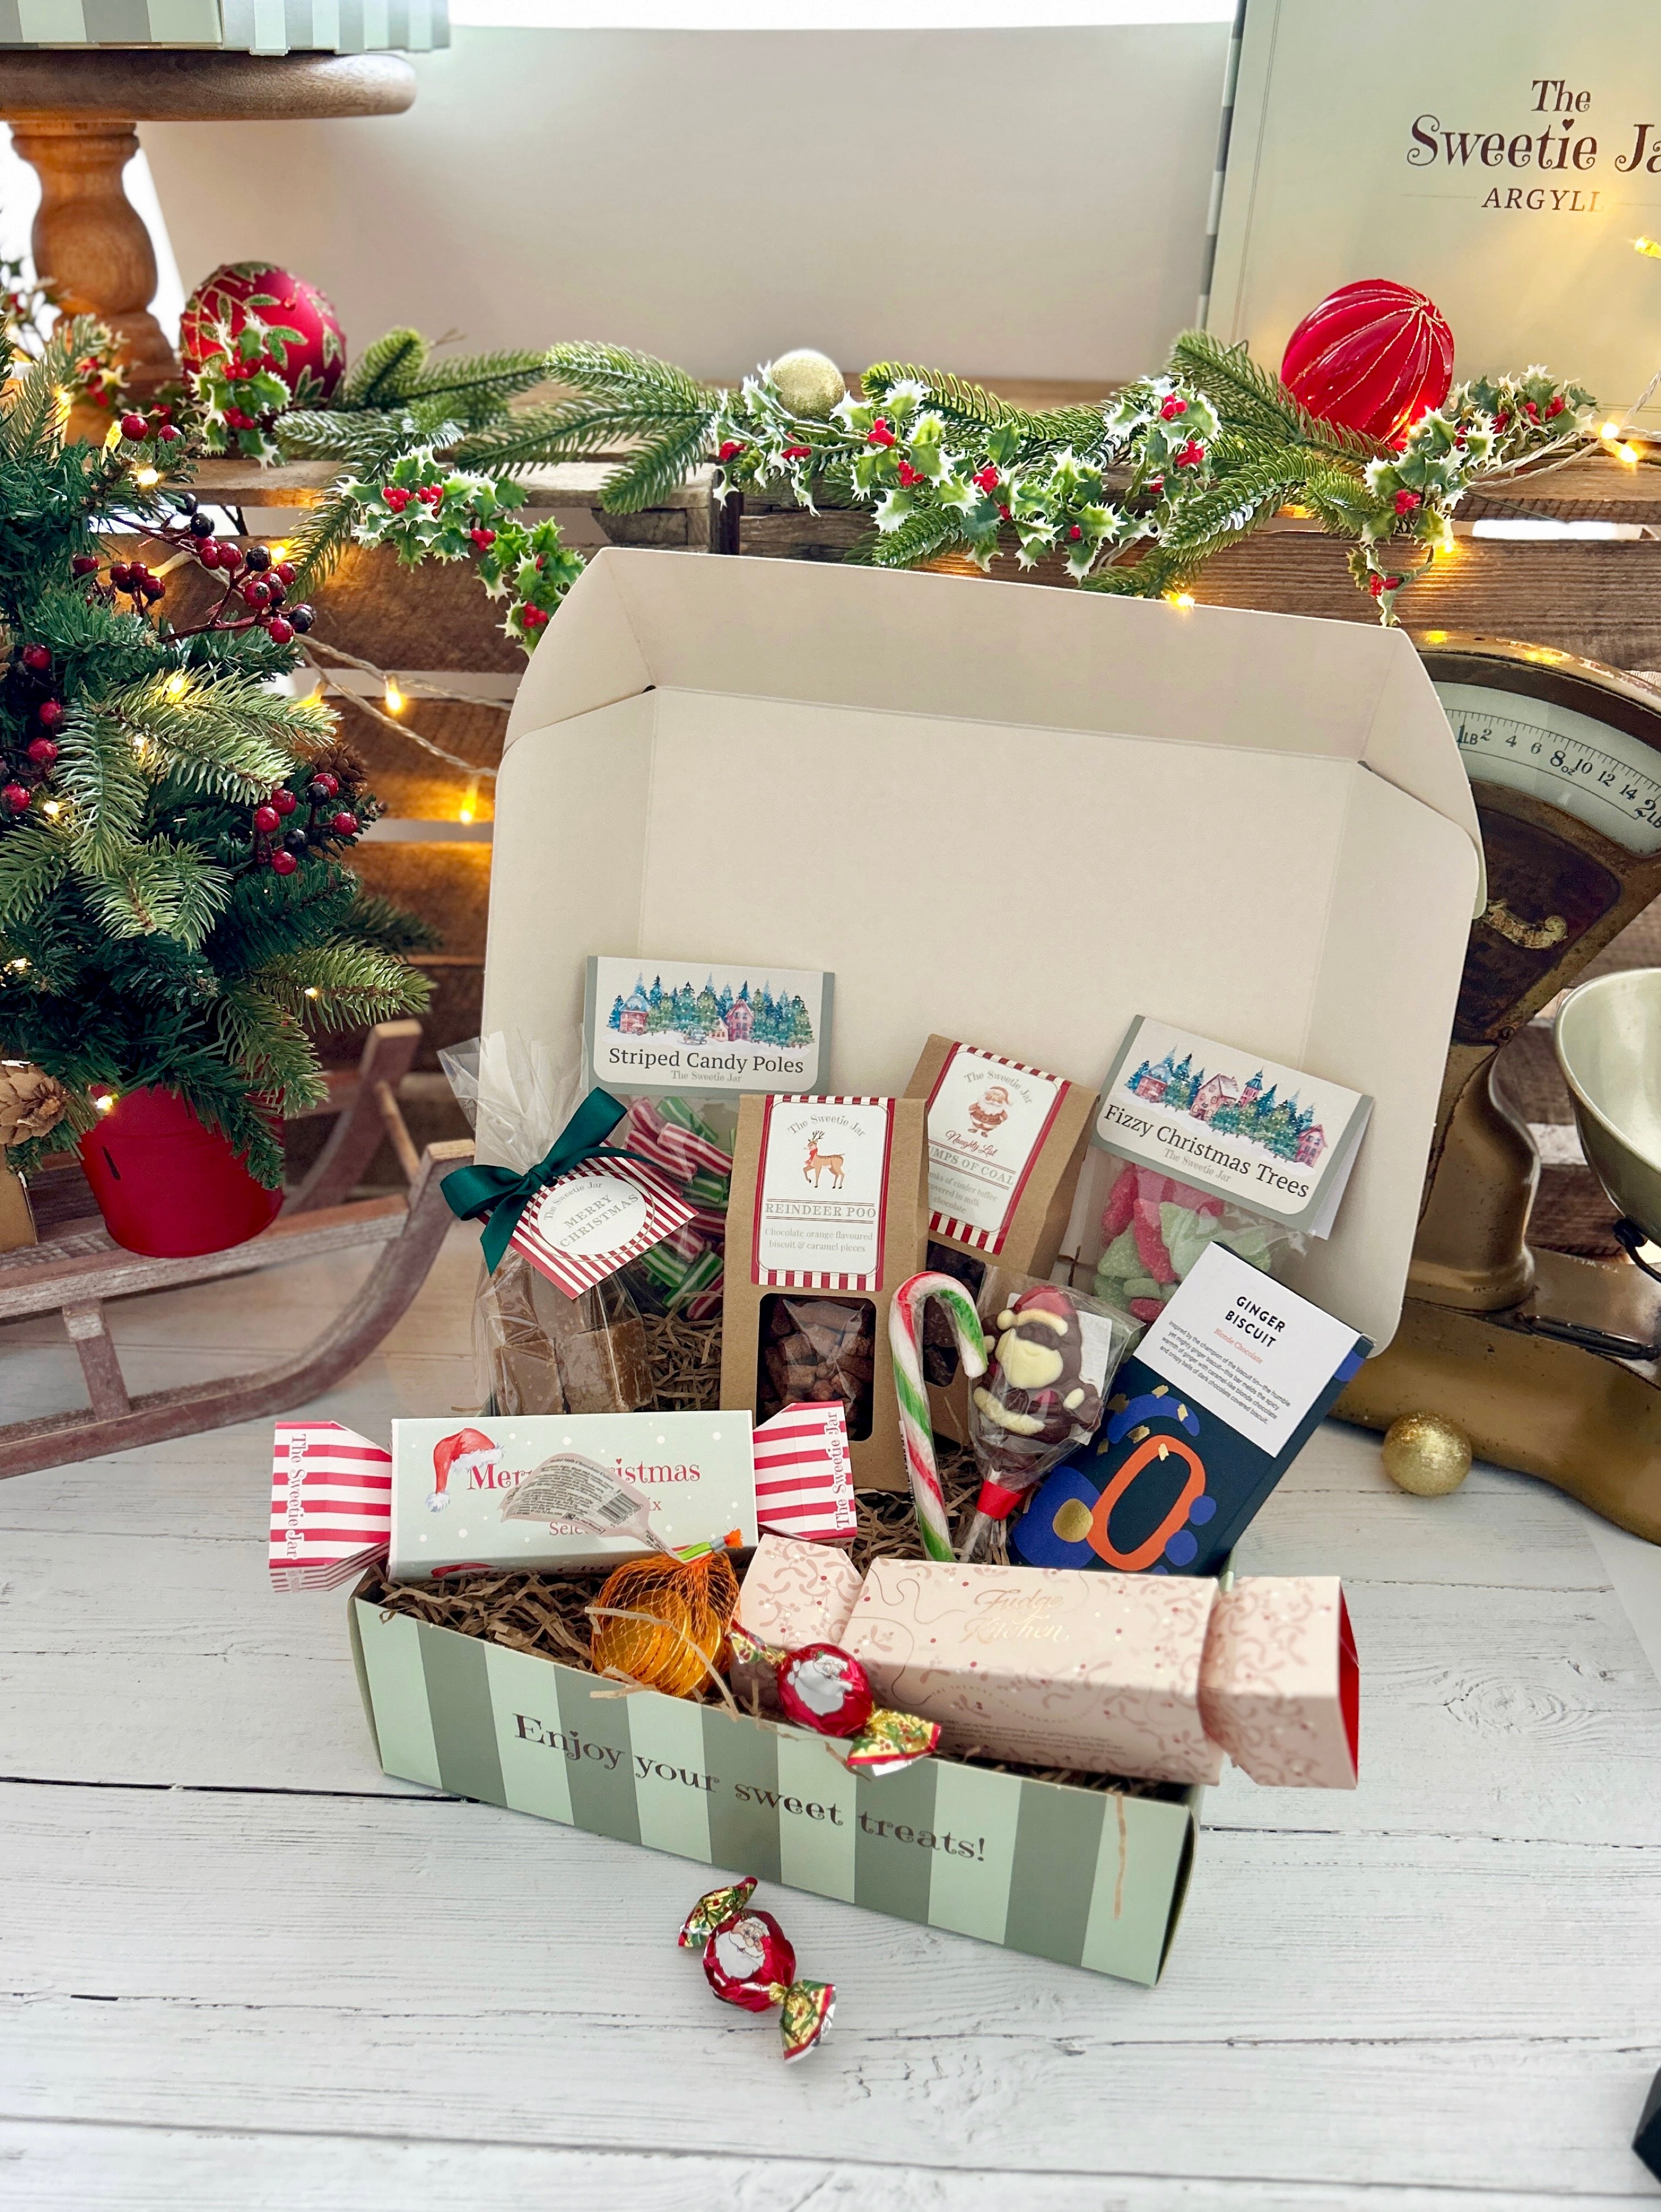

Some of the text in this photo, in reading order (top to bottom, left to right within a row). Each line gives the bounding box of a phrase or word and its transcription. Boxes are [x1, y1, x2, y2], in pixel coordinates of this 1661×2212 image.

[1531, 80, 1591, 113] The
[1407, 114, 1597, 170] Sweetie
[1481, 187, 1605, 213] ARGYLL
[1480, 729, 1492, 741] 2
[1505, 735, 1517, 747] 4
[1531, 742, 1542, 754] 6
[1574, 759, 1593, 775] 10
[1597, 771, 1616, 787] 12
[1619, 784, 1637, 801] 14
[609, 1048, 804, 1074] Striped Candy Poles
[671, 1070, 742, 1082] The Sweetie Jar
[963, 1070, 1033, 1104] The Sweetie Jar
[788, 1114, 866, 1137] The Sweetie Jar
[1104, 1104, 1309, 1198] Fizzy Christmas Trees
[1163, 1148, 1231, 1183] The Sweetie Jar
[962, 1159, 979, 1171] OF
[981, 1166, 1013, 1186] COAL
[544, 1181, 603, 1220] The Sweetie Jar
[564, 1194, 612, 1229] MERRY
[765, 1203, 876, 1218] REINDEER POO
[933, 1196, 967, 1213] chocolate
[964, 1197, 980, 1207] milk
[559, 1194, 639, 1248] CHRISTMAS
[765, 1227, 873, 1241] Chocolate orange flavoured
[769, 1240, 795, 1248] biscuit
[840, 1244, 865, 1253] pieces
[1225, 1310, 1277, 1348] BISCUIT
[1236, 1296, 1286, 1333] GINGER
[1186, 1332, 1192, 1340] by
[1192, 1336, 1201, 1345] the
[1228, 1361, 1236, 1369] the
[1214, 1327, 1263, 1364] Blonde Chocolate
[1183, 1352, 1199, 1363] ginger
[1235, 1387, 1253, 1402] blonde
[1252, 1400, 1277, 1420] chocolate
[1190, 1347, 1206, 1359] ginger
[1257, 1391, 1266, 1400] the
[1265, 1398, 1280, 1410] spicy
[291, 1433, 306, 1464] The
[467, 1463, 532, 1491] Mer
[826, 1411, 850, 1529] The Sweetie Jar
[287, 1469, 304, 1527] Sweetie
[286, 1531, 304, 1558] Jar
[974, 1588, 1063, 1615] Fudge
[512, 1712, 986, 1862] Enjoy your sweet treats!
